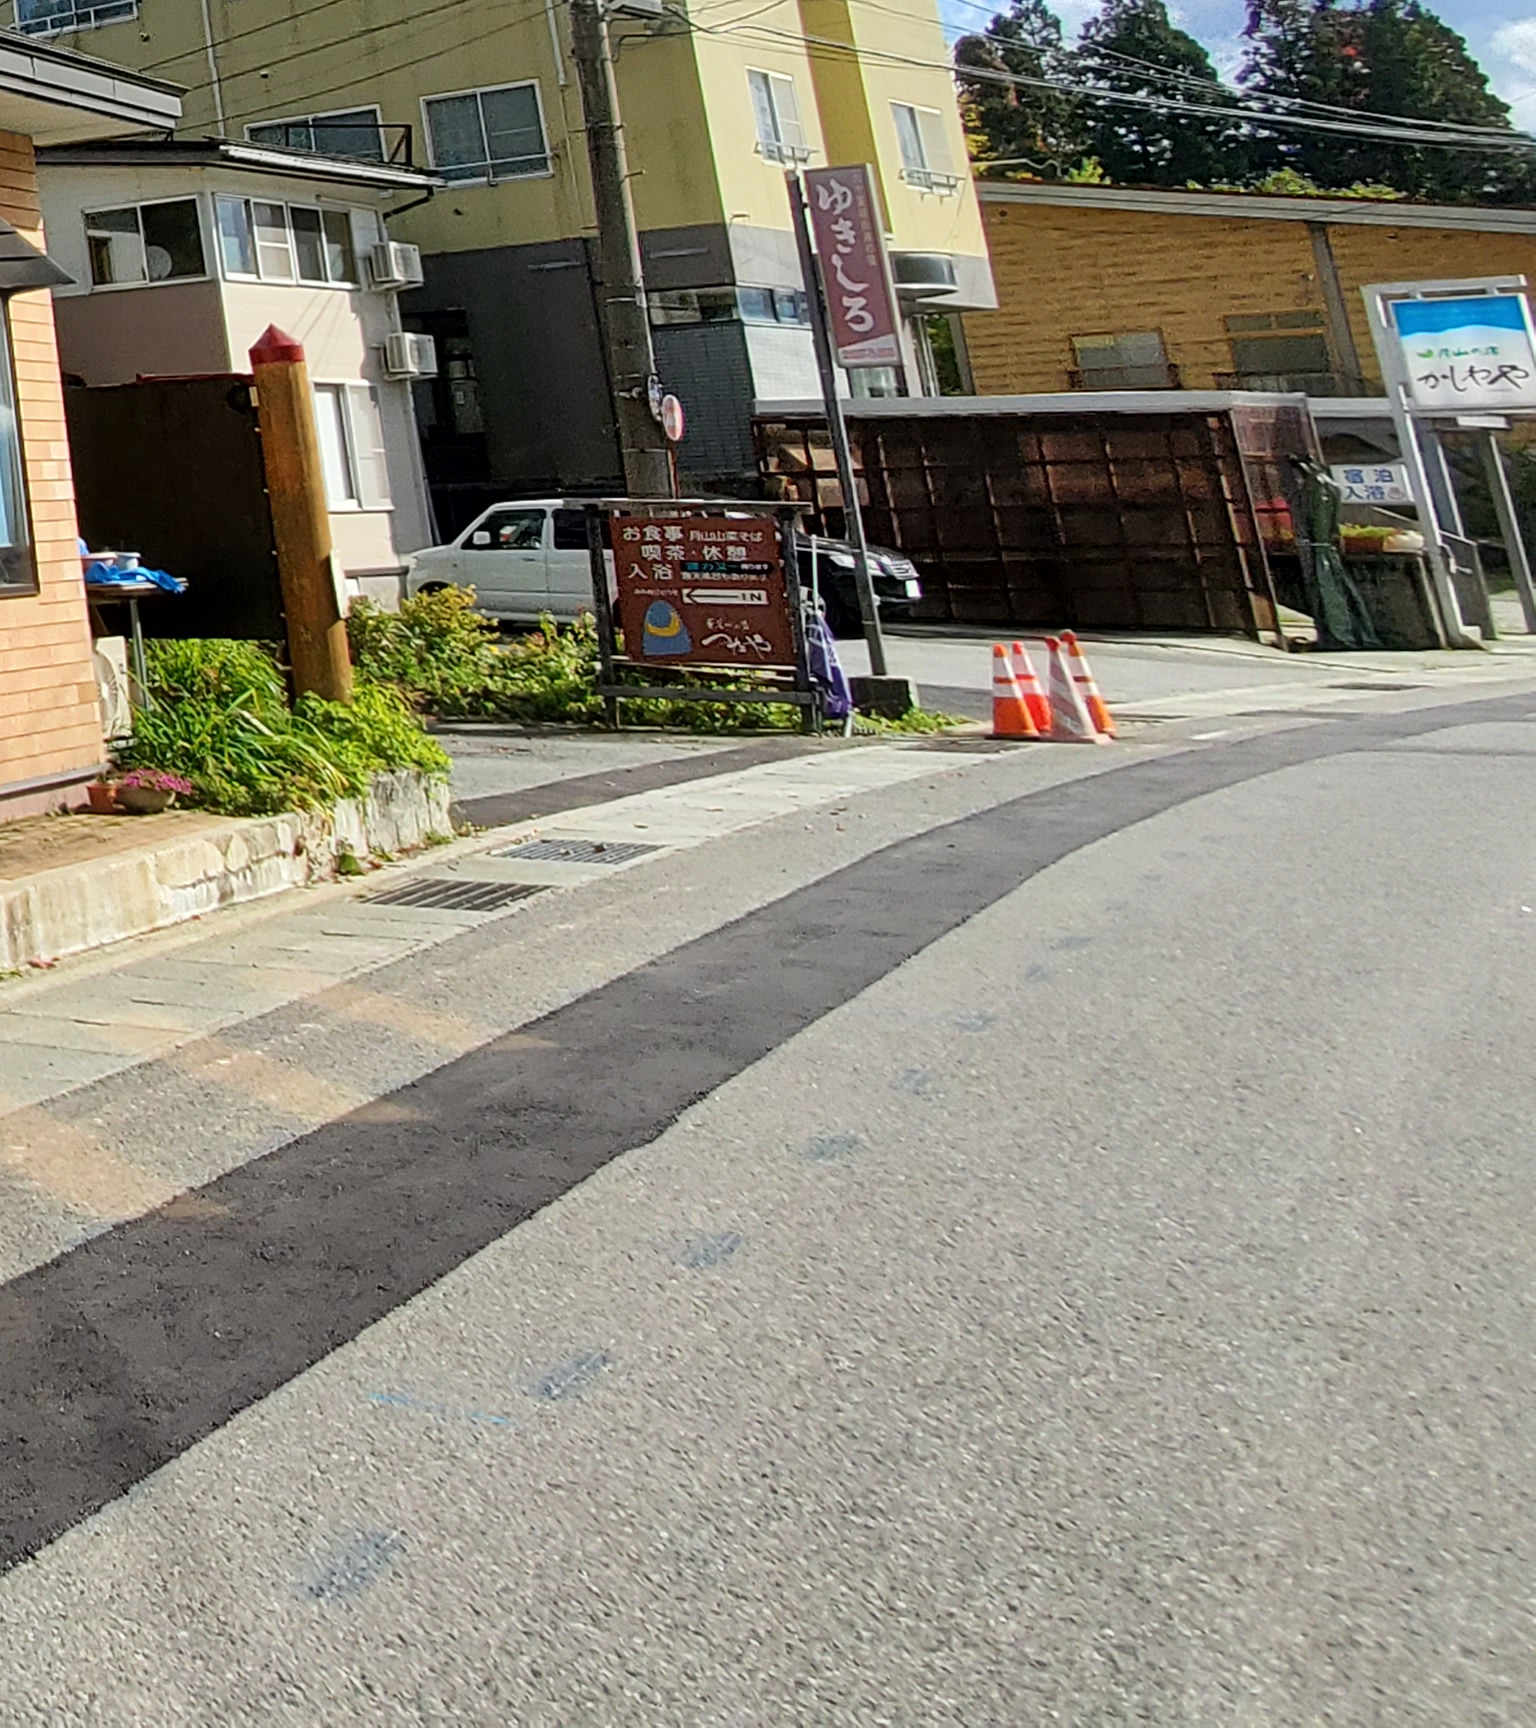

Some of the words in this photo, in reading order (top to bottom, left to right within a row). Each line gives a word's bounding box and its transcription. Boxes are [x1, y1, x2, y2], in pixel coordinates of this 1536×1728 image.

[816, 178, 875, 332] ゆきしろ
[1416, 365, 1530, 393] かしわや
[1343, 468, 1395, 483] 宿泊
[1344, 485, 1385, 500] 入浴
[622, 524, 684, 543] お食事
[628, 562, 673, 581] 入浴
[741, 592, 762, 602] IN
